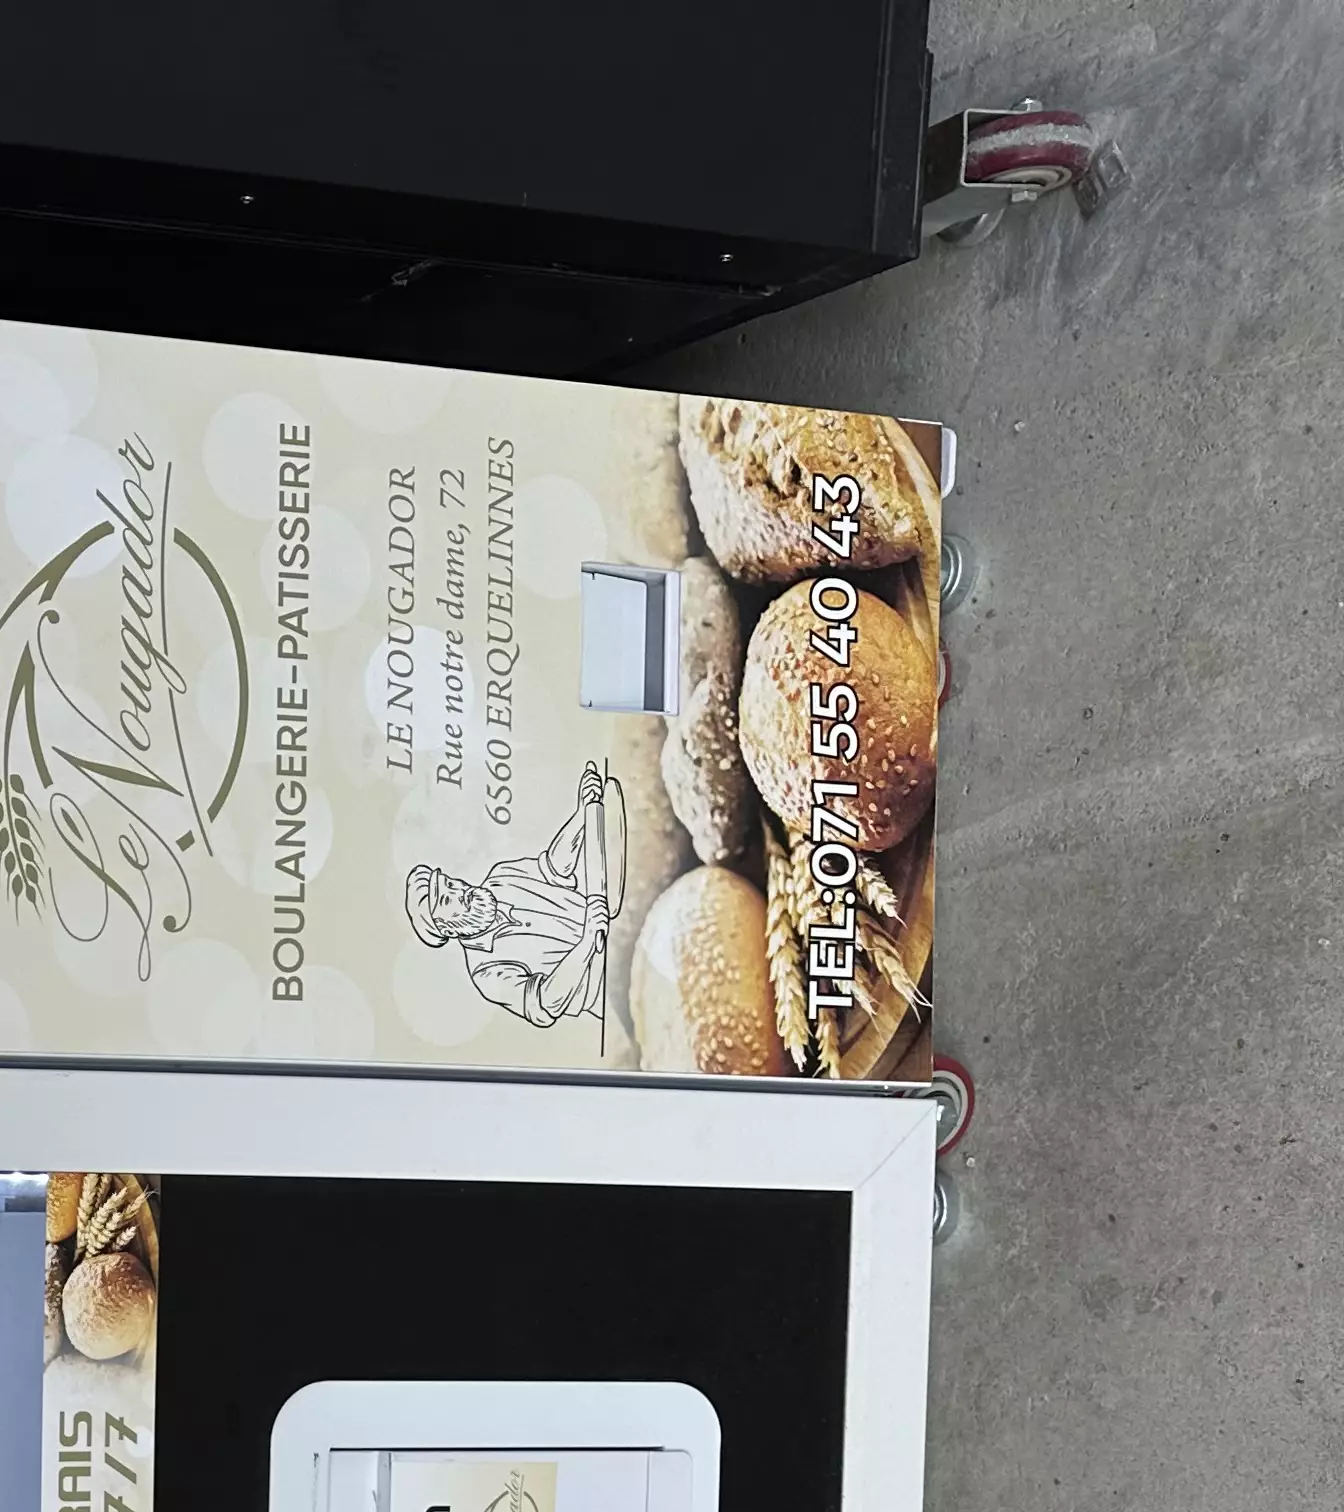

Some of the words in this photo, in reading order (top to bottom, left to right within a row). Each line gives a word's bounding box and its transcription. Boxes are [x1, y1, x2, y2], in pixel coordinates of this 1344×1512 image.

[439, 469, 465, 510] 72
[813, 474, 861, 558] 43
[387, 465, 416, 715] NOUGADOR
[437, 521, 470, 620] dame,
[487, 437, 520, 732] ERQUELINNES
[811, 578, 859, 665] 40
[37, 432, 191, 933] Nougador
[271, 423, 311, 1002] BOULANGERIE-PATISSERIE
[438, 630, 465, 715] notre
[386, 723, 413, 774] LE
[436, 724, 464, 789] Rue
[811, 684, 858, 762] 55
[485, 738, 512, 826] 6560
[48, 793, 152, 981] Le
[808, 781, 858, 1020] TEL:071
